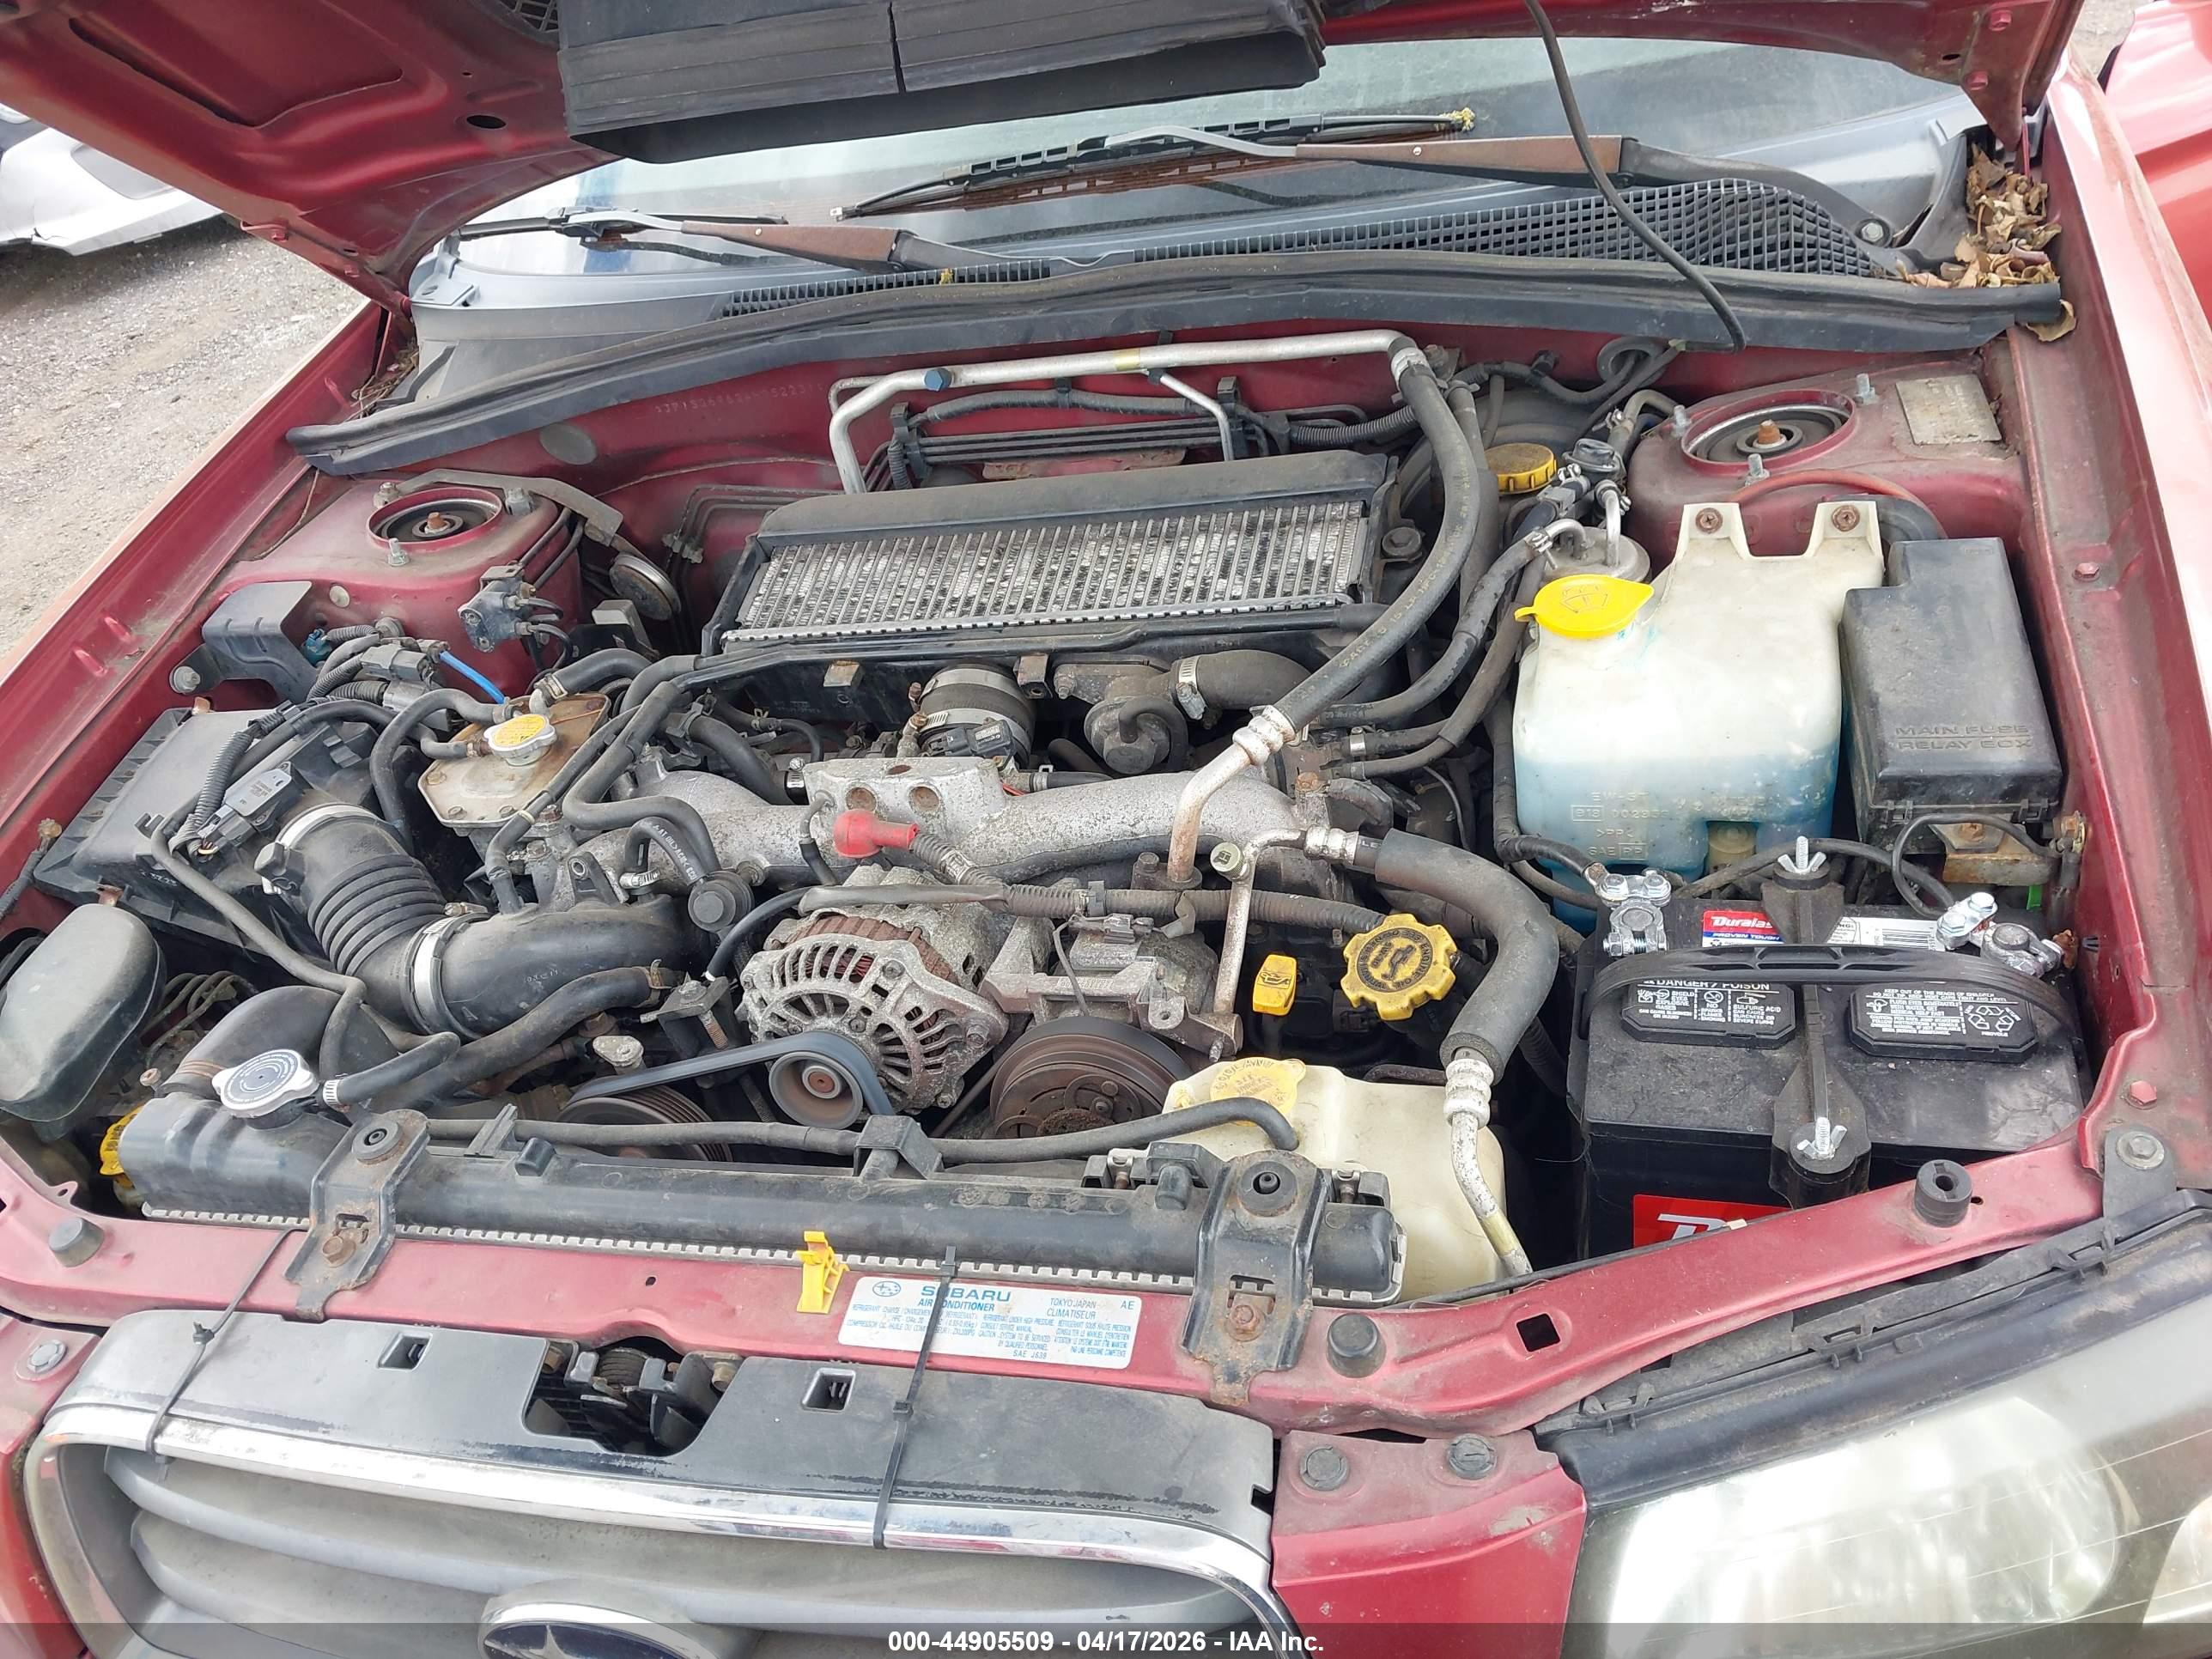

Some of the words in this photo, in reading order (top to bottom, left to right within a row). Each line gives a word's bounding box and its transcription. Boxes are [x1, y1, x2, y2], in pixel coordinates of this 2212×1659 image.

[1895, 726, 1959, 736] MAIN
[1965, 725, 2029, 735] FUSE
[1898, 740, 1972, 750] RELAY
[1980, 738, 2033, 749] BOX
[921, 1285, 1012, 1303] SBARU
[917, 1297, 933, 1307] AIR
[941, 1300, 995, 1312] ONDITIONER
[1120, 1300, 1135, 1310] AE
[1046, 1308, 1097, 1320] CLIMATISEUR
[1012, 1349, 1027, 1358] SAE
